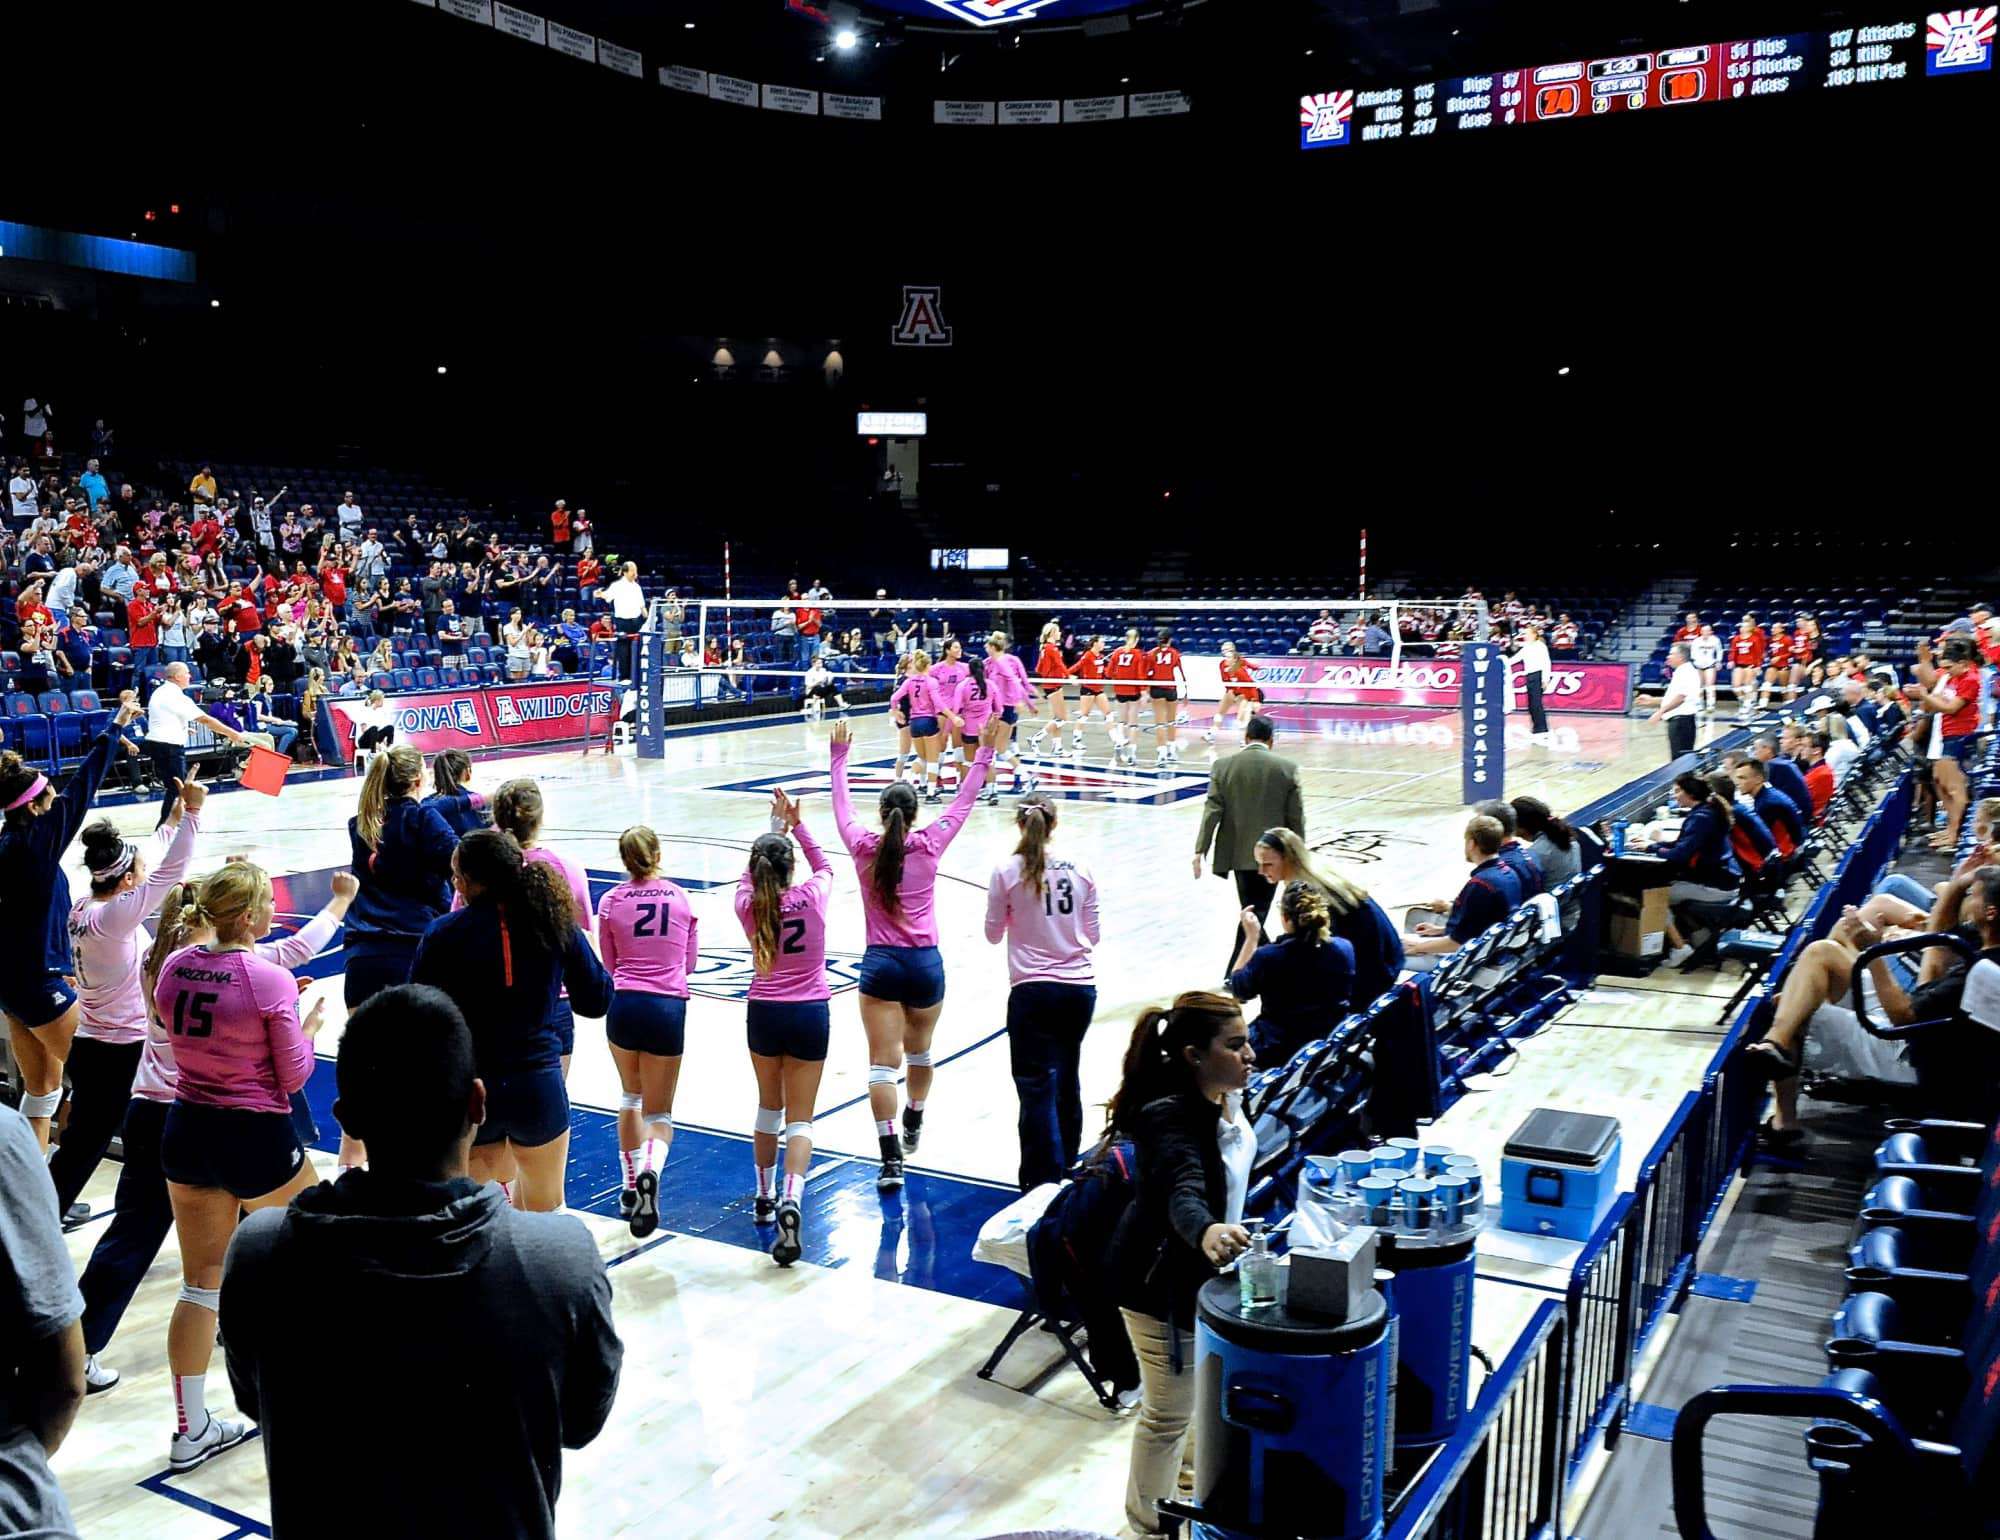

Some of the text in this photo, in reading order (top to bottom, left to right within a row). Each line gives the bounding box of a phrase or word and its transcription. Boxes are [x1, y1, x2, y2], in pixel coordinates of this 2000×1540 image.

[1857, 22, 1916, 43] Attacks
[1752, 38, 1787, 57] Digs
[1857, 44, 1892, 63] Kills
[1752, 56, 1803, 75] Blocks
[1463, 77, 1493, 93] Digs
[1751, 77, 1789, 95] Aces
[1356, 88, 1403, 107] Attacks
[1447, 94, 1491, 113] Blocks
[1544, 88, 1573, 115] 24
[1375, 105, 1403, 121] Kills
[1459, 113, 1492, 129] Aces
[1118, 653, 1134, 666] 17
[1156, 652, 1172, 665] 14
[1252, 667, 1306, 685] OWN
[519, 691, 612, 721] WILDCATS
[1471, 658, 1491, 784] WILDCATS
[623, 888, 675, 900] ARIZONA
[1043, 876, 1074, 916] 13
[633, 902, 670, 937] 21
[783, 918, 806, 955] 2
[172, 966, 233, 984] ARIZONA
[172, 991, 219, 1038] 15
[1447, 1273, 1466, 1421] POWERADE
[1360, 1357, 1377, 1522] POWERADE
